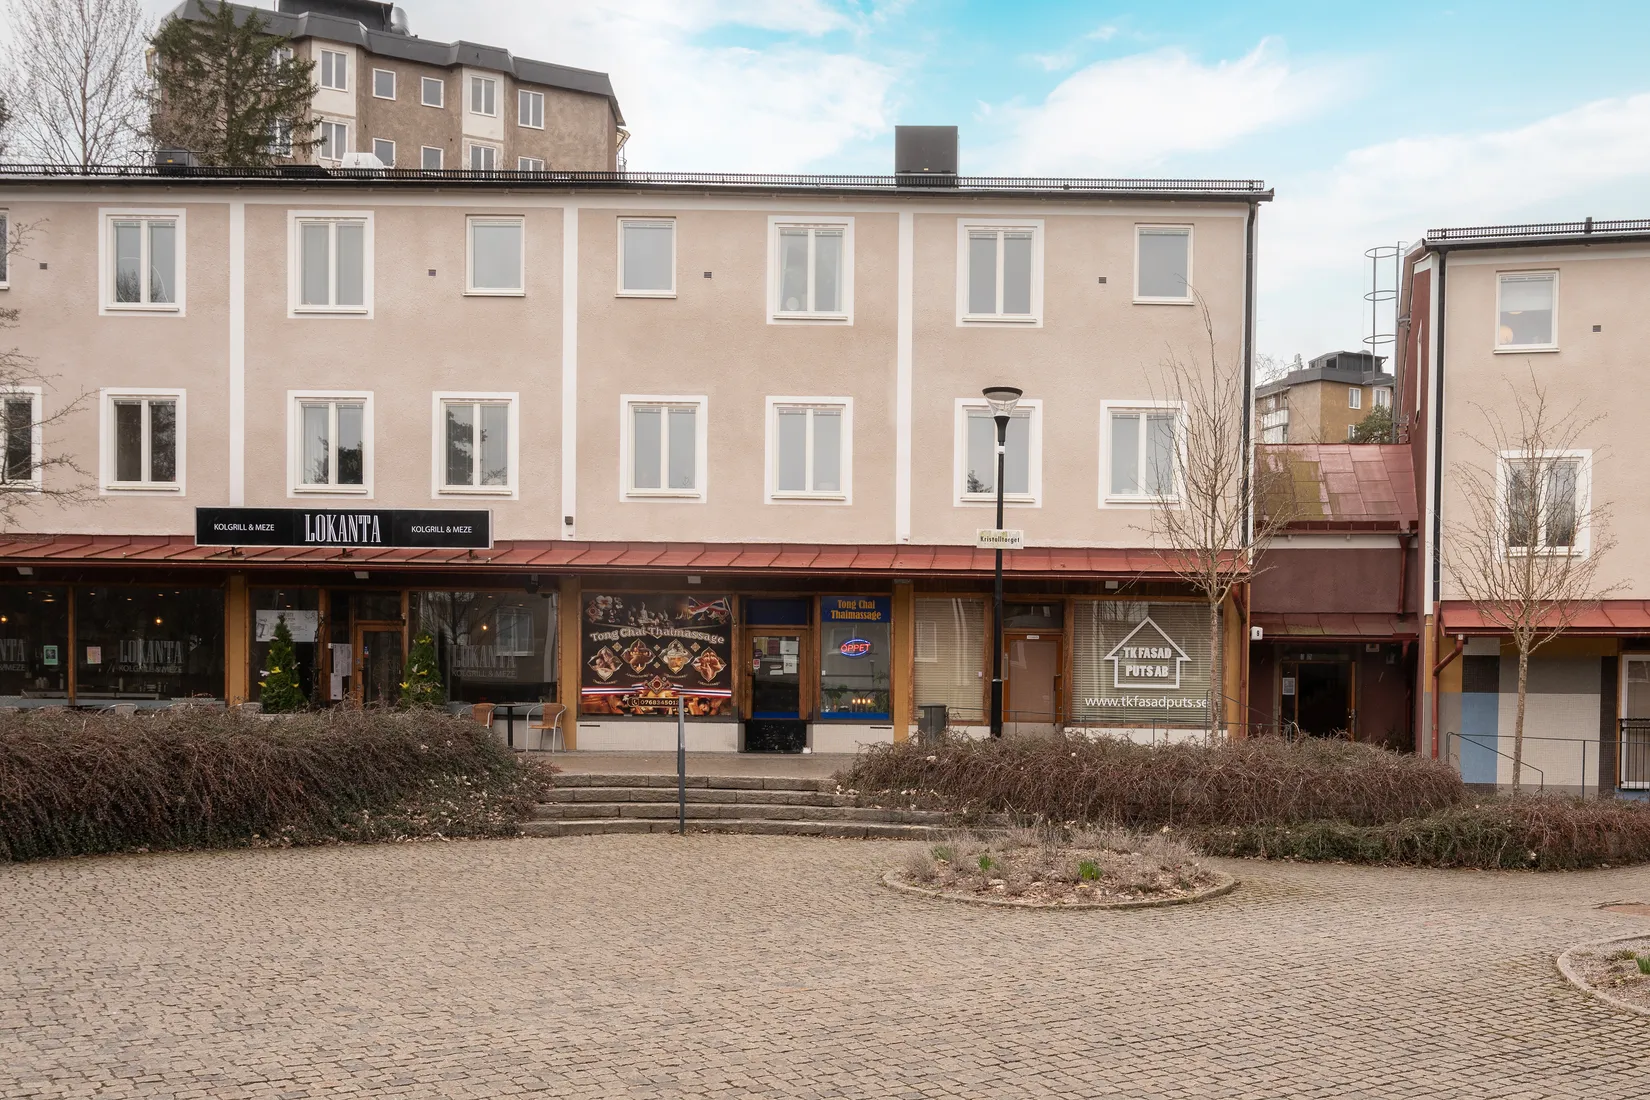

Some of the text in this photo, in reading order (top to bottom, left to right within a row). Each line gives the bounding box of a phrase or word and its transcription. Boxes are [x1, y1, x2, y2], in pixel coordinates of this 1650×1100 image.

[213, 523, 247, 531] KOLGRILL
[255, 524, 275, 532] MEZE
[304, 514, 381, 543] LOKANTA
[411, 525, 445, 533] KOLGRILL
[453, 526, 473, 534] MEZE
[980, 536, 1020, 544] Kristalltorget
[837, 599, 876, 610] Tong Chai
[831, 609, 882, 620] Thaimassage
[590, 626, 725, 644] Tong Chai Thaimassage
[119, 640, 184, 663] LOKANTA
[452, 645, 517, 668] LOKANTA
[1123, 647, 1172, 659] TK FASAD
[1125, 665, 1169, 677] PUTS AB
[1084, 695, 1209, 709] www.tkfasadputs.se
